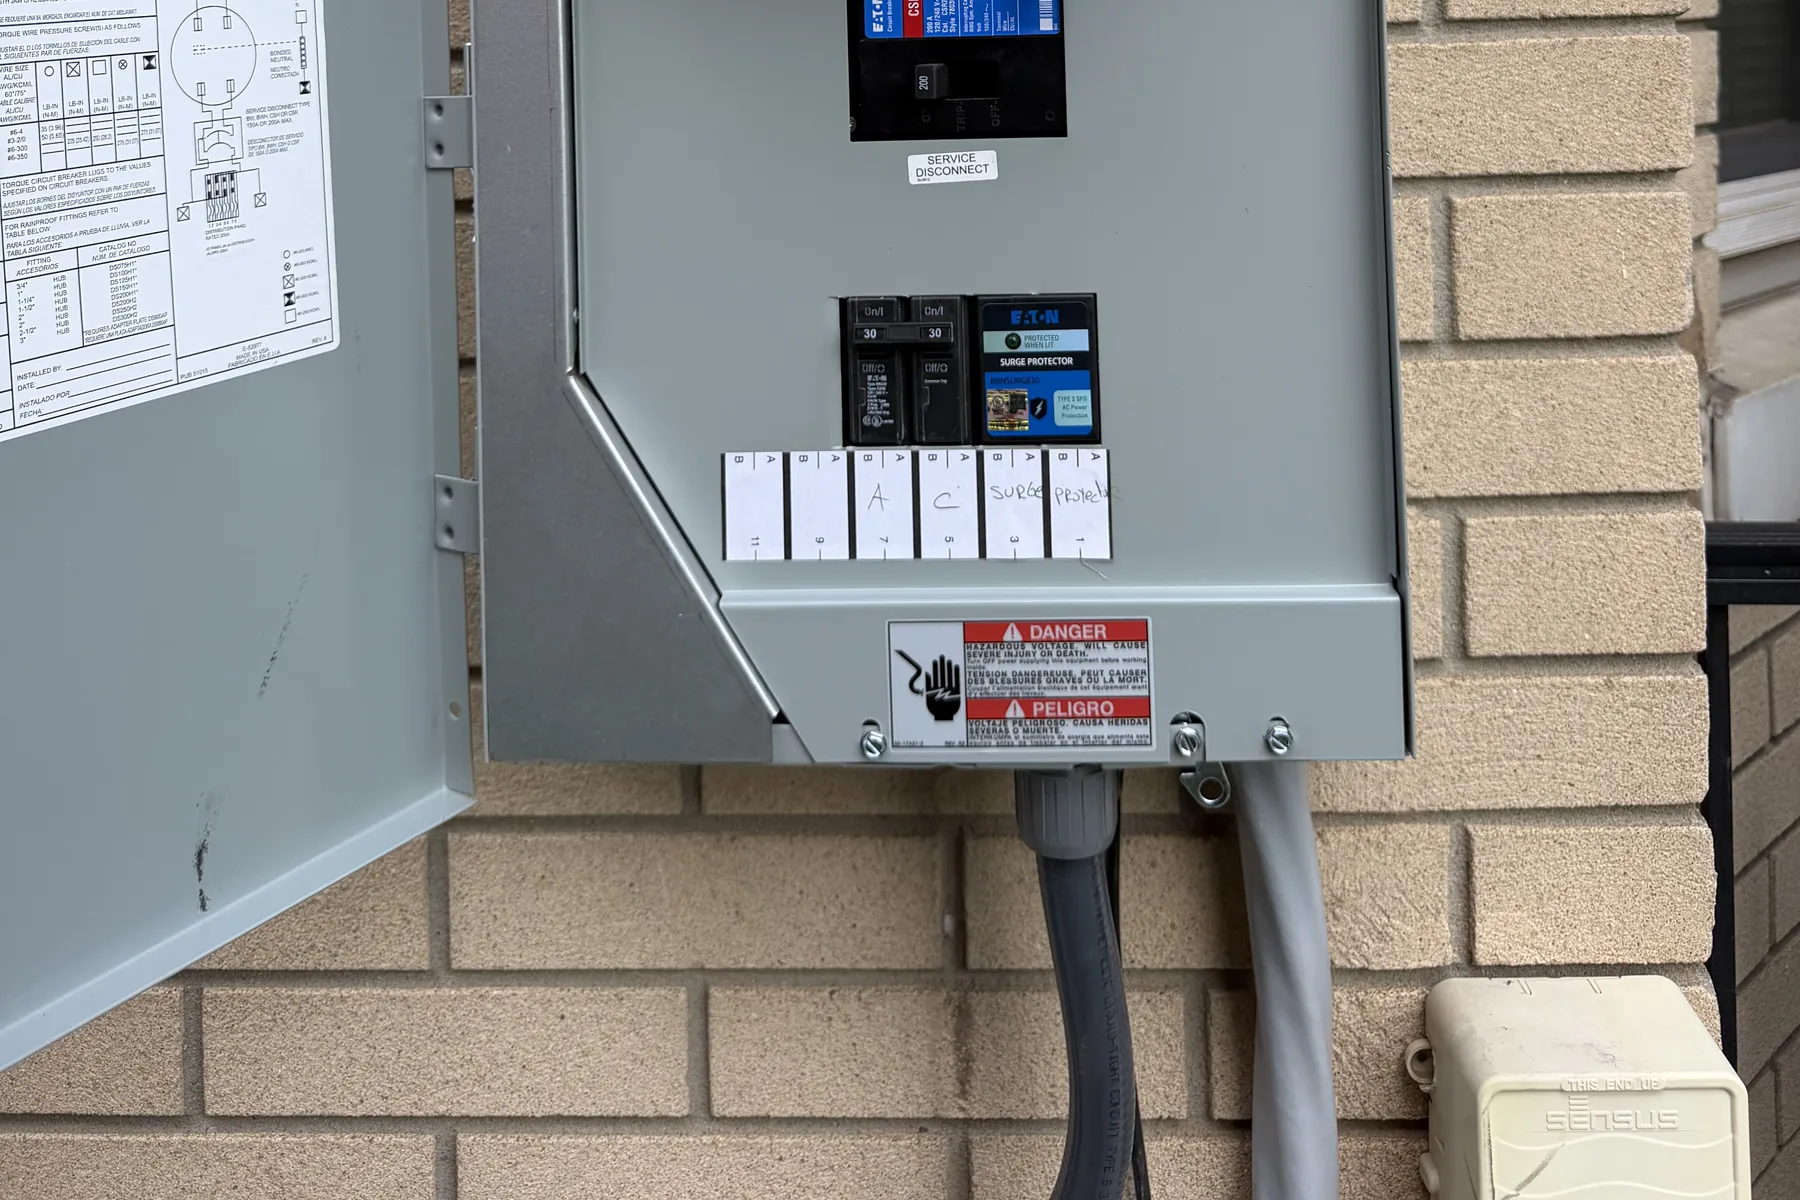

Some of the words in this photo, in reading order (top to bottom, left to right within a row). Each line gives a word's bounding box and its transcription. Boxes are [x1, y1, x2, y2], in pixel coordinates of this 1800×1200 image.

[919, 75, 929, 90] 200
[927, 153, 976, 165] SERVICE
[2, 179, 29, 189] TORQUE
[31, 176, 56, 185] CIRCUIT
[58, 171, 88, 181] BREAKER
[88, 167, 105, 176] LUGS
[116, 164, 127, 172] THE
[128, 161, 152, 170] VALUES
[916, 164, 989, 178] DISCONNECT
[5, 223, 18, 231] FOR
[20, 216, 57, 228] RAINPROOF
[59, 212, 88, 222] FITTINGS
[88, 208, 108, 217] REFER
[98, 241, 126, 253] CATALOG
[26, 256, 51, 266] FITTING
[16, 263, 59, 277] ACCESORIOS
[863, 328, 877, 339] 30
[928, 328, 942, 338] 30
[1024, 341, 1044, 349] WHEN
[1000, 357, 1026, 366] SURGE
[1027, 357, 1074, 366] PROTECTOR
[16, 367, 52, 381] INSTALLED
[17, 382, 36, 392] DATE:
[19, 394, 55, 409] INSTALADO
[734, 455, 744, 463] B
[766, 454, 776, 463] A
[831, 454, 840, 462] A
[863, 454, 873, 462] B
[895, 453, 905, 461] A
[928, 453, 937, 461] B
[960, 453, 970, 461] A
[992, 453, 1002, 461] B
[1025, 452, 1035, 461] A
[1091, 452, 1101, 460] A
[867, 483, 890, 511] A
[751, 536, 760, 546] 11
[815, 536, 825, 544] 9
[1030, 624, 1107, 640] DANGER
[1032, 642, 1078, 650] VOLTAGE.
[1113, 641, 1146, 649] CAUSE
[967, 650, 1001, 658] SEVERE
[967, 677, 985, 685] DES
[1046, 676, 1083, 684] GRAVES
[1118, 675, 1147, 683] MORT.
[1032, 701, 1114, 716] PELIGRO
[1012, 719, 1068, 727] PELIGROSO.
[1108, 718, 1148, 726] HERIDAS
[1013, 726, 1019, 734] O
[1022, 726, 1063, 734] MUERTE.
[1567, 1079, 1598, 1091] THIS
[1606, 1079, 1633, 1091] END
[1640, 1079, 1660, 1091] UP
